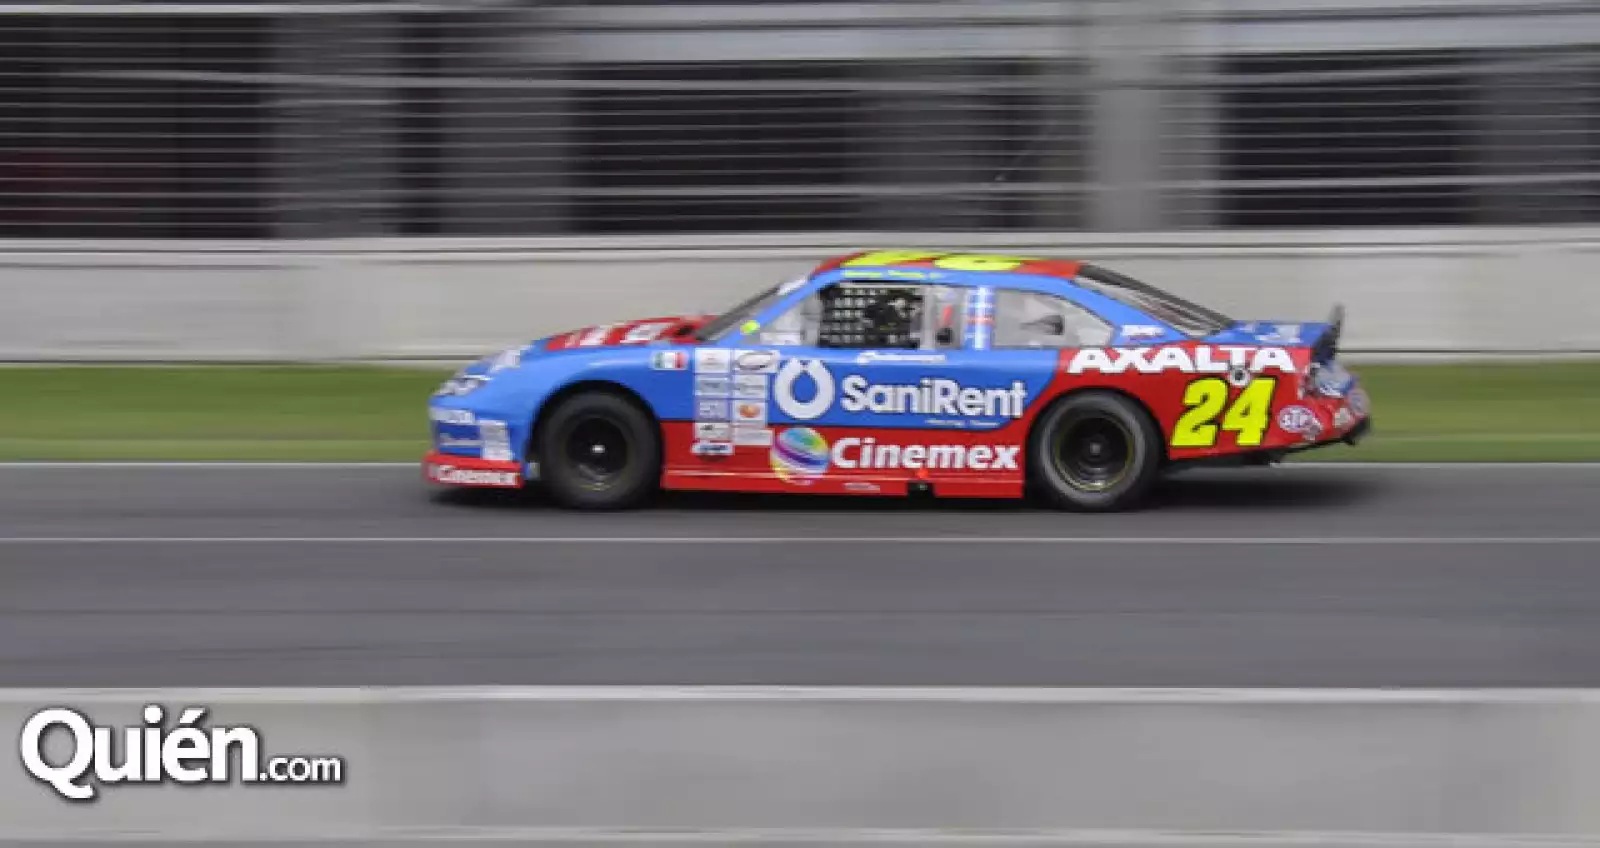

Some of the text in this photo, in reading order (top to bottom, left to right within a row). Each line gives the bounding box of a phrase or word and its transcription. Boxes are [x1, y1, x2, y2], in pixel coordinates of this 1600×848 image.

[1067, 347, 1296, 373] AXALTA
[840, 374, 1028, 418] SaniRent
[1170, 376, 1276, 446] 24
[830, 437, 1021, 469] Cinemex
